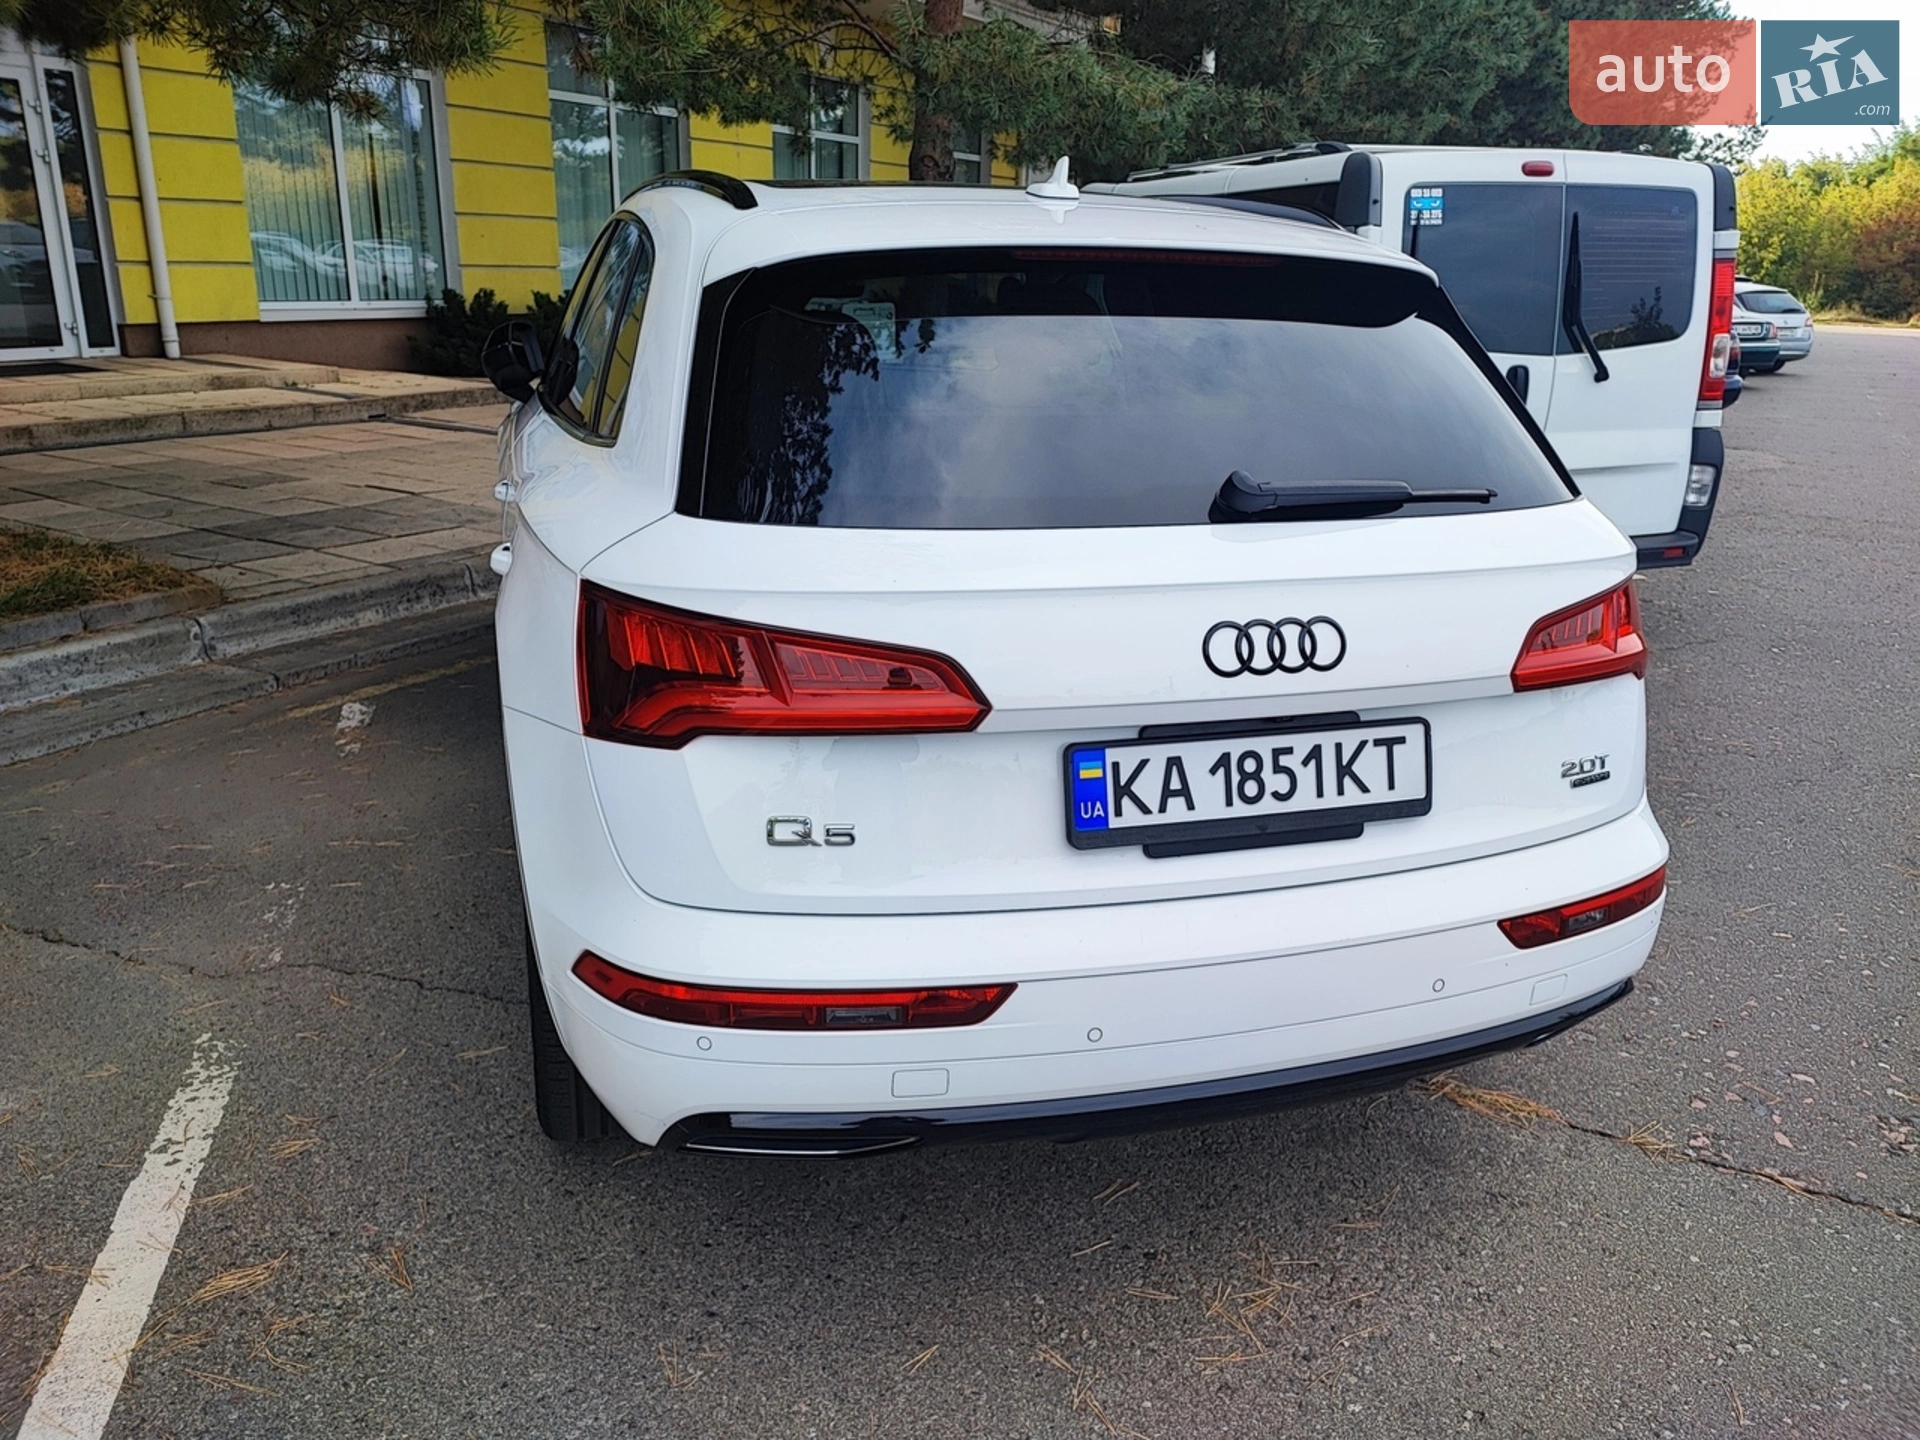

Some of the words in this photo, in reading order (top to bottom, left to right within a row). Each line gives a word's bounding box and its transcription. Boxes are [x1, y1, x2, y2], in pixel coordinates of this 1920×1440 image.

[1111, 755, 1196, 818] KA
[1080, 800, 1105, 819] UA
[766, 815, 856, 847] Q5
